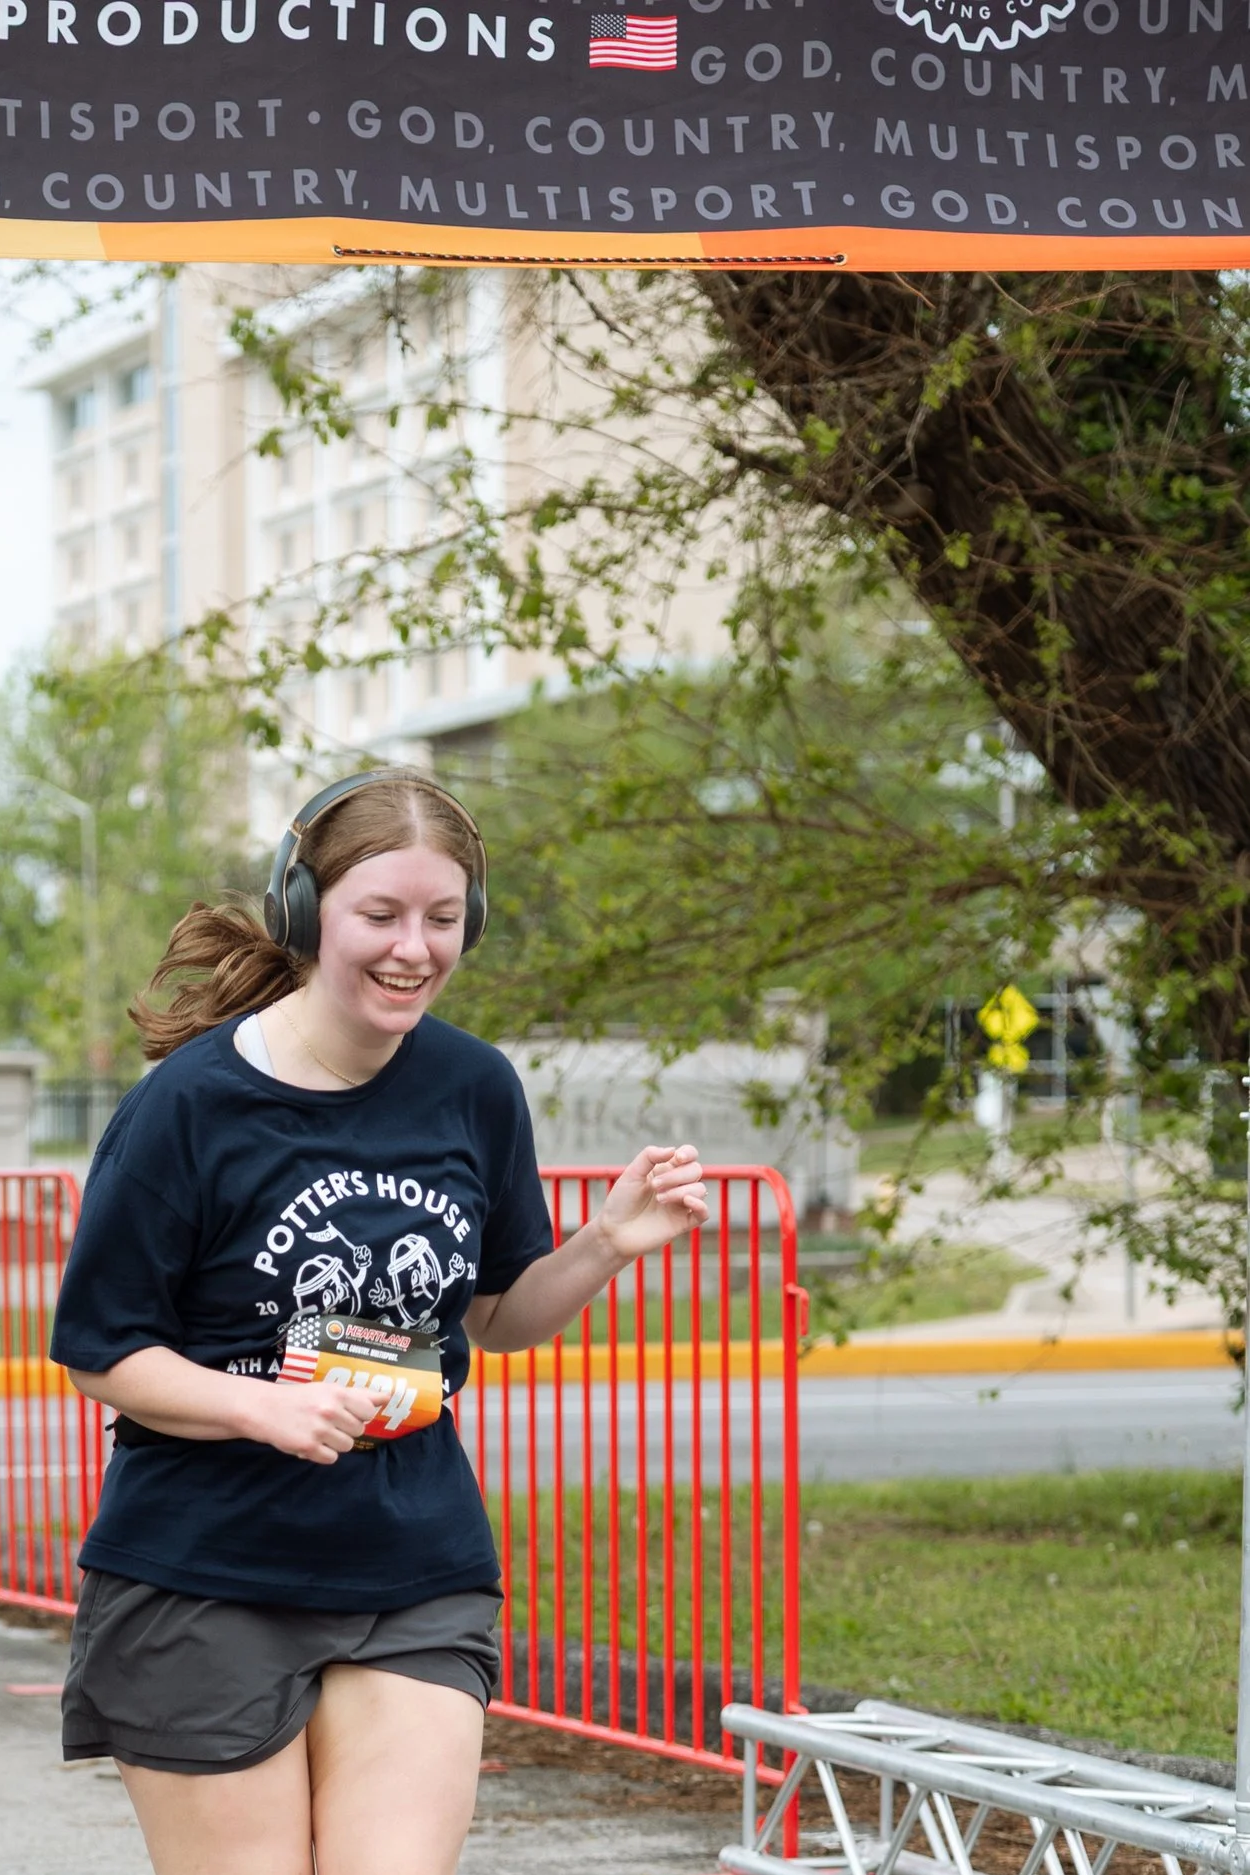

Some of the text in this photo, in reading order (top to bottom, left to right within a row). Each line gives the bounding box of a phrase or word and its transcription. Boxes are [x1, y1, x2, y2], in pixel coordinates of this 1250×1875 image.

[690, 40, 843, 85] GOD,
[870, 47, 1177, 107] COUNTRY,
[347, 99, 494, 154] GOD,
[524, 111, 845, 157] COUNTRY,
[873, 117, 1246, 171] MULTISPOR
[41, 168, 369, 211] COUNTRY,
[399, 175, 817, 222] MULTISPORT
[880, 184, 1030, 229] GOD,
[1056, 196, 1244, 229] COUN
[253, 1170, 471, 1277] POTTER'S HOUSE
[255, 1301, 279, 1316] 20
[345, 1324, 412, 1349] HEARTLAND
[227, 1357, 262, 1375] 4TH
